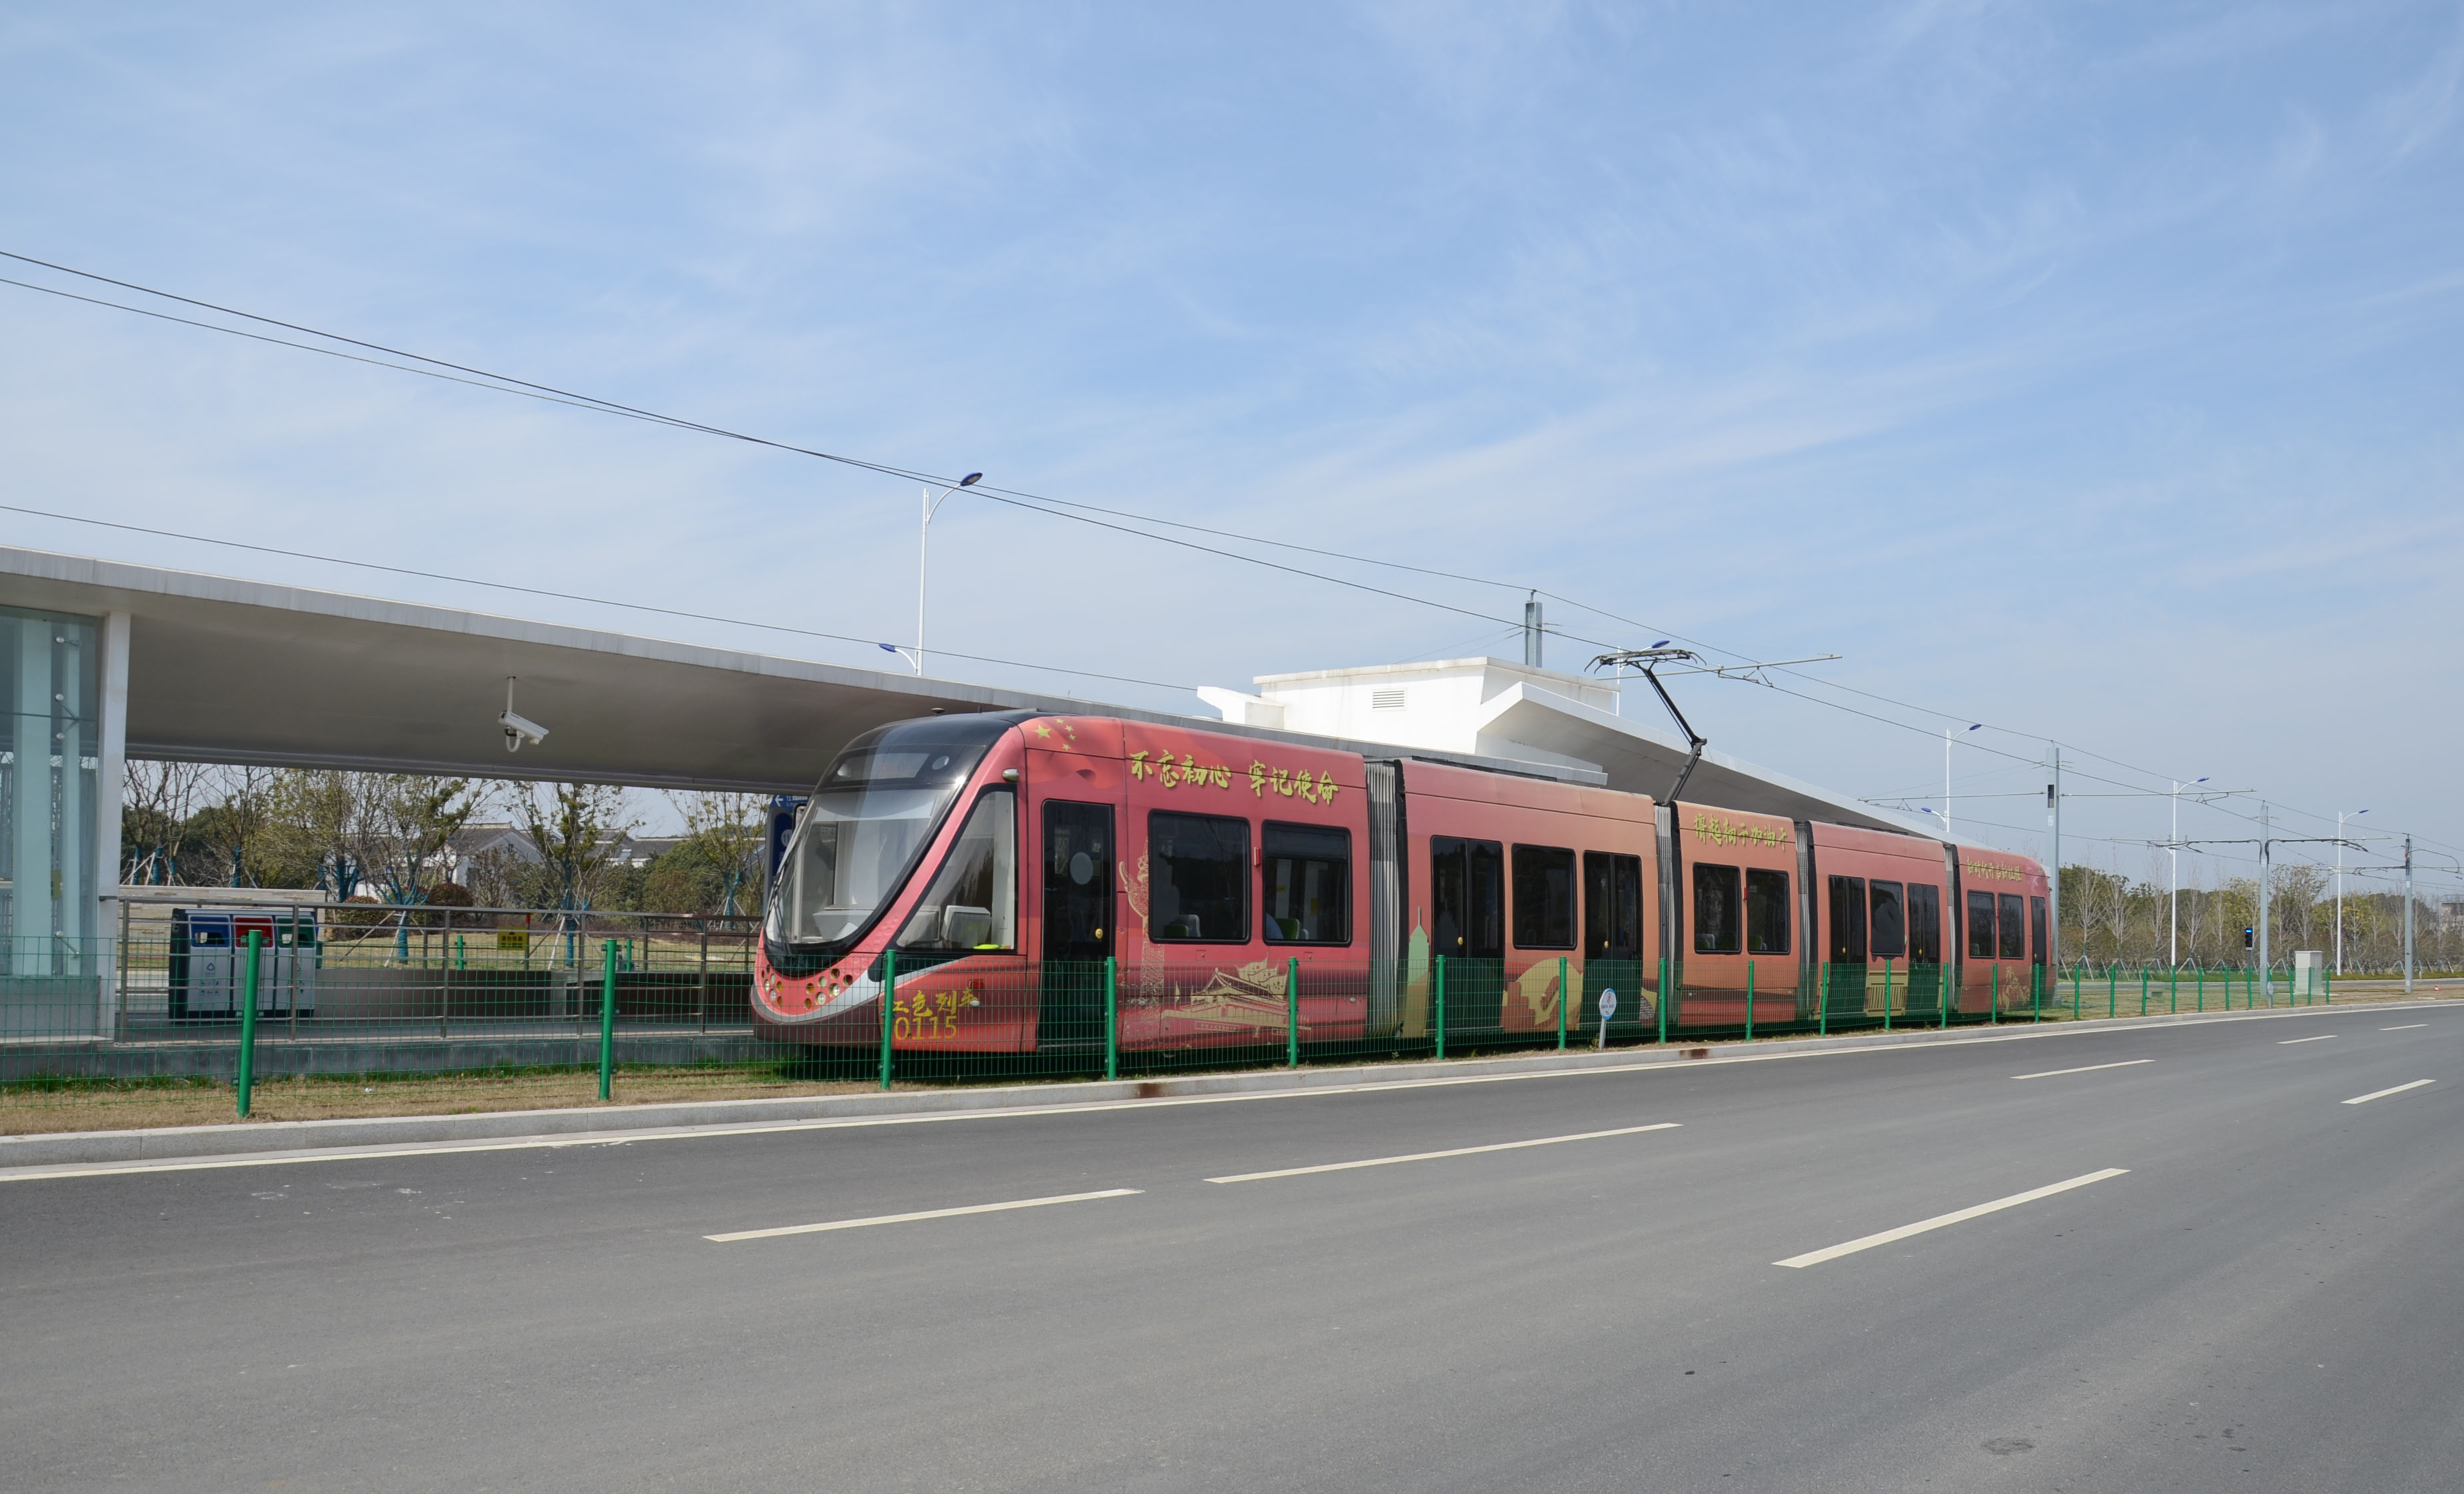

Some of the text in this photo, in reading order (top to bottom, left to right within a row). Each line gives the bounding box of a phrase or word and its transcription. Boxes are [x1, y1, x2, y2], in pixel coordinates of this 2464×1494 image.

[1130, 749, 1339, 805] 不忘初心 牢记使命
[894, 1015, 957, 1040] 0115
